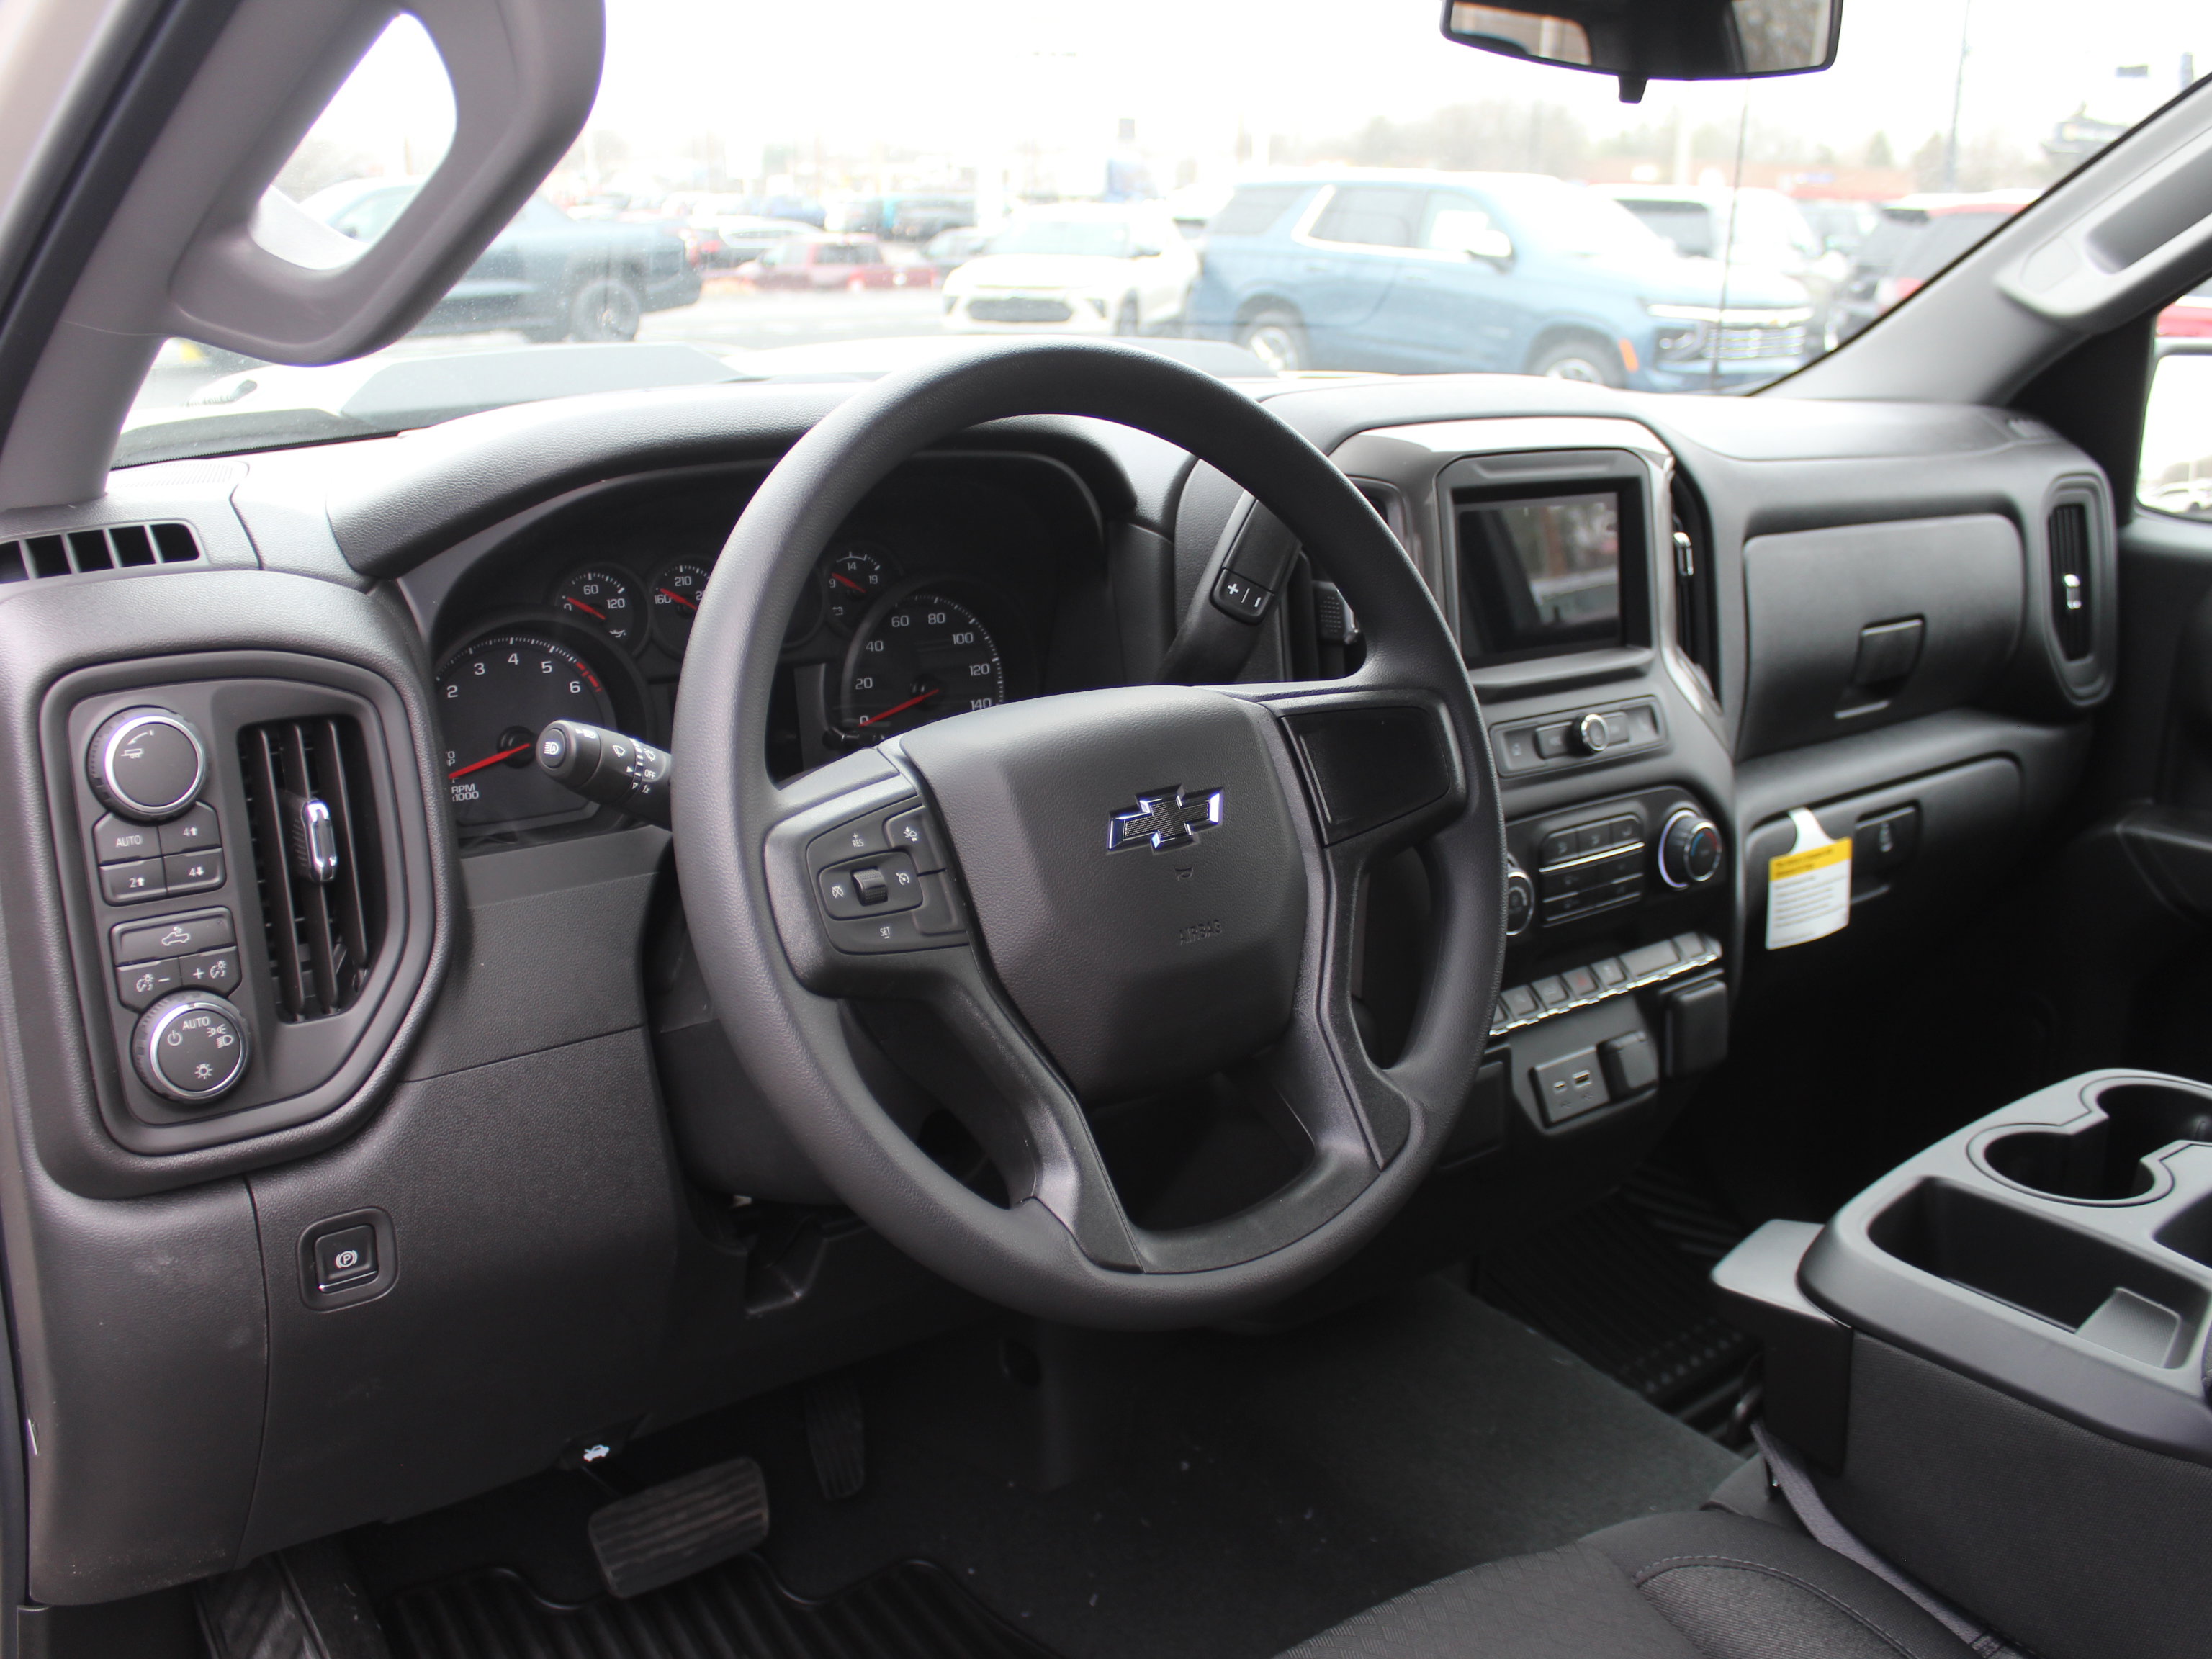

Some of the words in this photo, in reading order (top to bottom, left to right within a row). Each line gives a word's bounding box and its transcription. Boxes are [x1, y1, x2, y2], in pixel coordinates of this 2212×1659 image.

[674, 576, 692, 587] 210
[829, 578, 836, 588] 9
[868, 575, 878, 585] 19
[583, 584, 599, 595] 60
[606, 598, 625, 609] 120
[654, 593, 672, 604] 160
[891, 615, 909, 627] 60
[927, 612, 945, 625] 80
[952, 631, 974, 645] 100
[865, 639, 884, 652] 40
[508, 652, 519, 665] 4
[474, 662, 485, 675] 3
[541, 660, 553, 673] 5
[968, 662, 990, 676] 120
[569, 680, 581, 693] 6
[855, 677, 873, 690] 20
[446, 684, 459, 698] 2
[969, 697, 992, 711] 140
[644, 768, 656, 780] OFF
[451, 783, 475, 794] RPM
[642, 784, 651, 795] 1x
[115, 834, 143, 848] AUTO
[852, 839, 864, 848] RES
[880, 926, 891, 936] SET
[181, 1015, 211, 1031] AUTO
